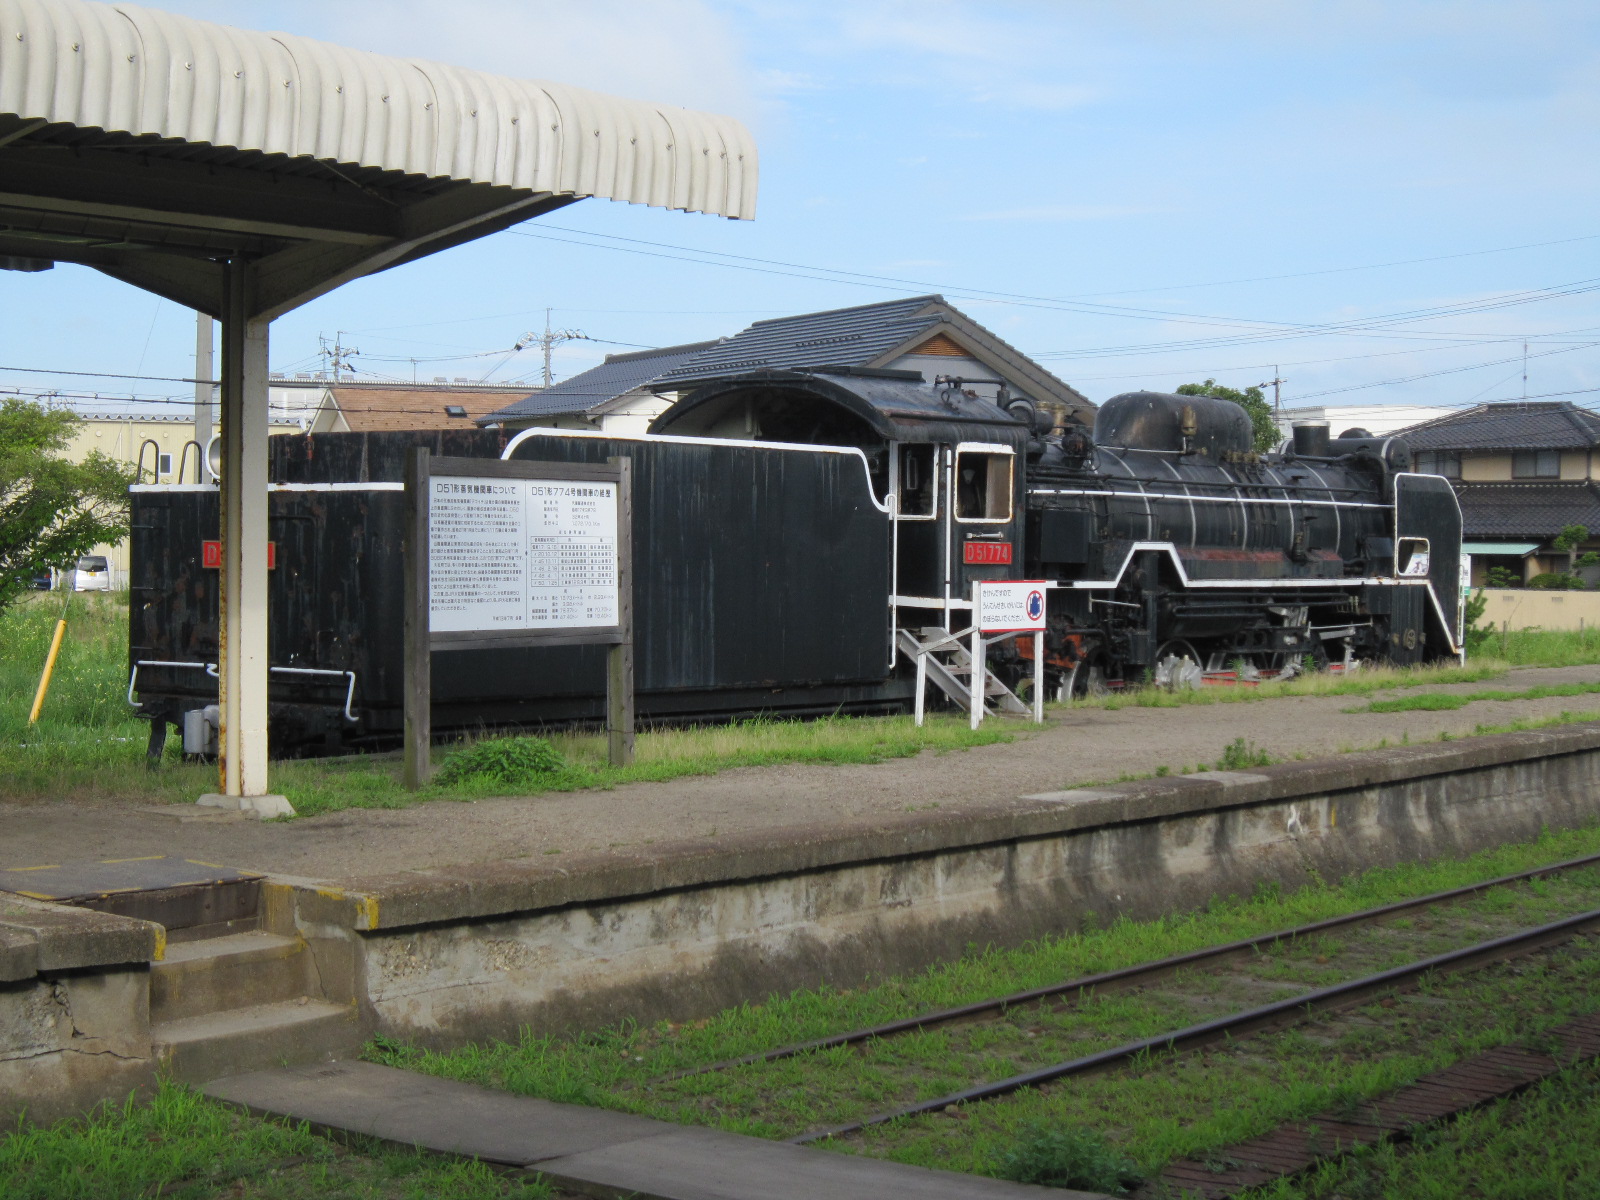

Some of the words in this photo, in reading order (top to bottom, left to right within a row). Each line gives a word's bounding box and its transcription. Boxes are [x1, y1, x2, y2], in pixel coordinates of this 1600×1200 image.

[436, 483, 516, 495] D51形蒸気機関車について
[531, 486, 611, 498] D51形774号機関車の経歴
